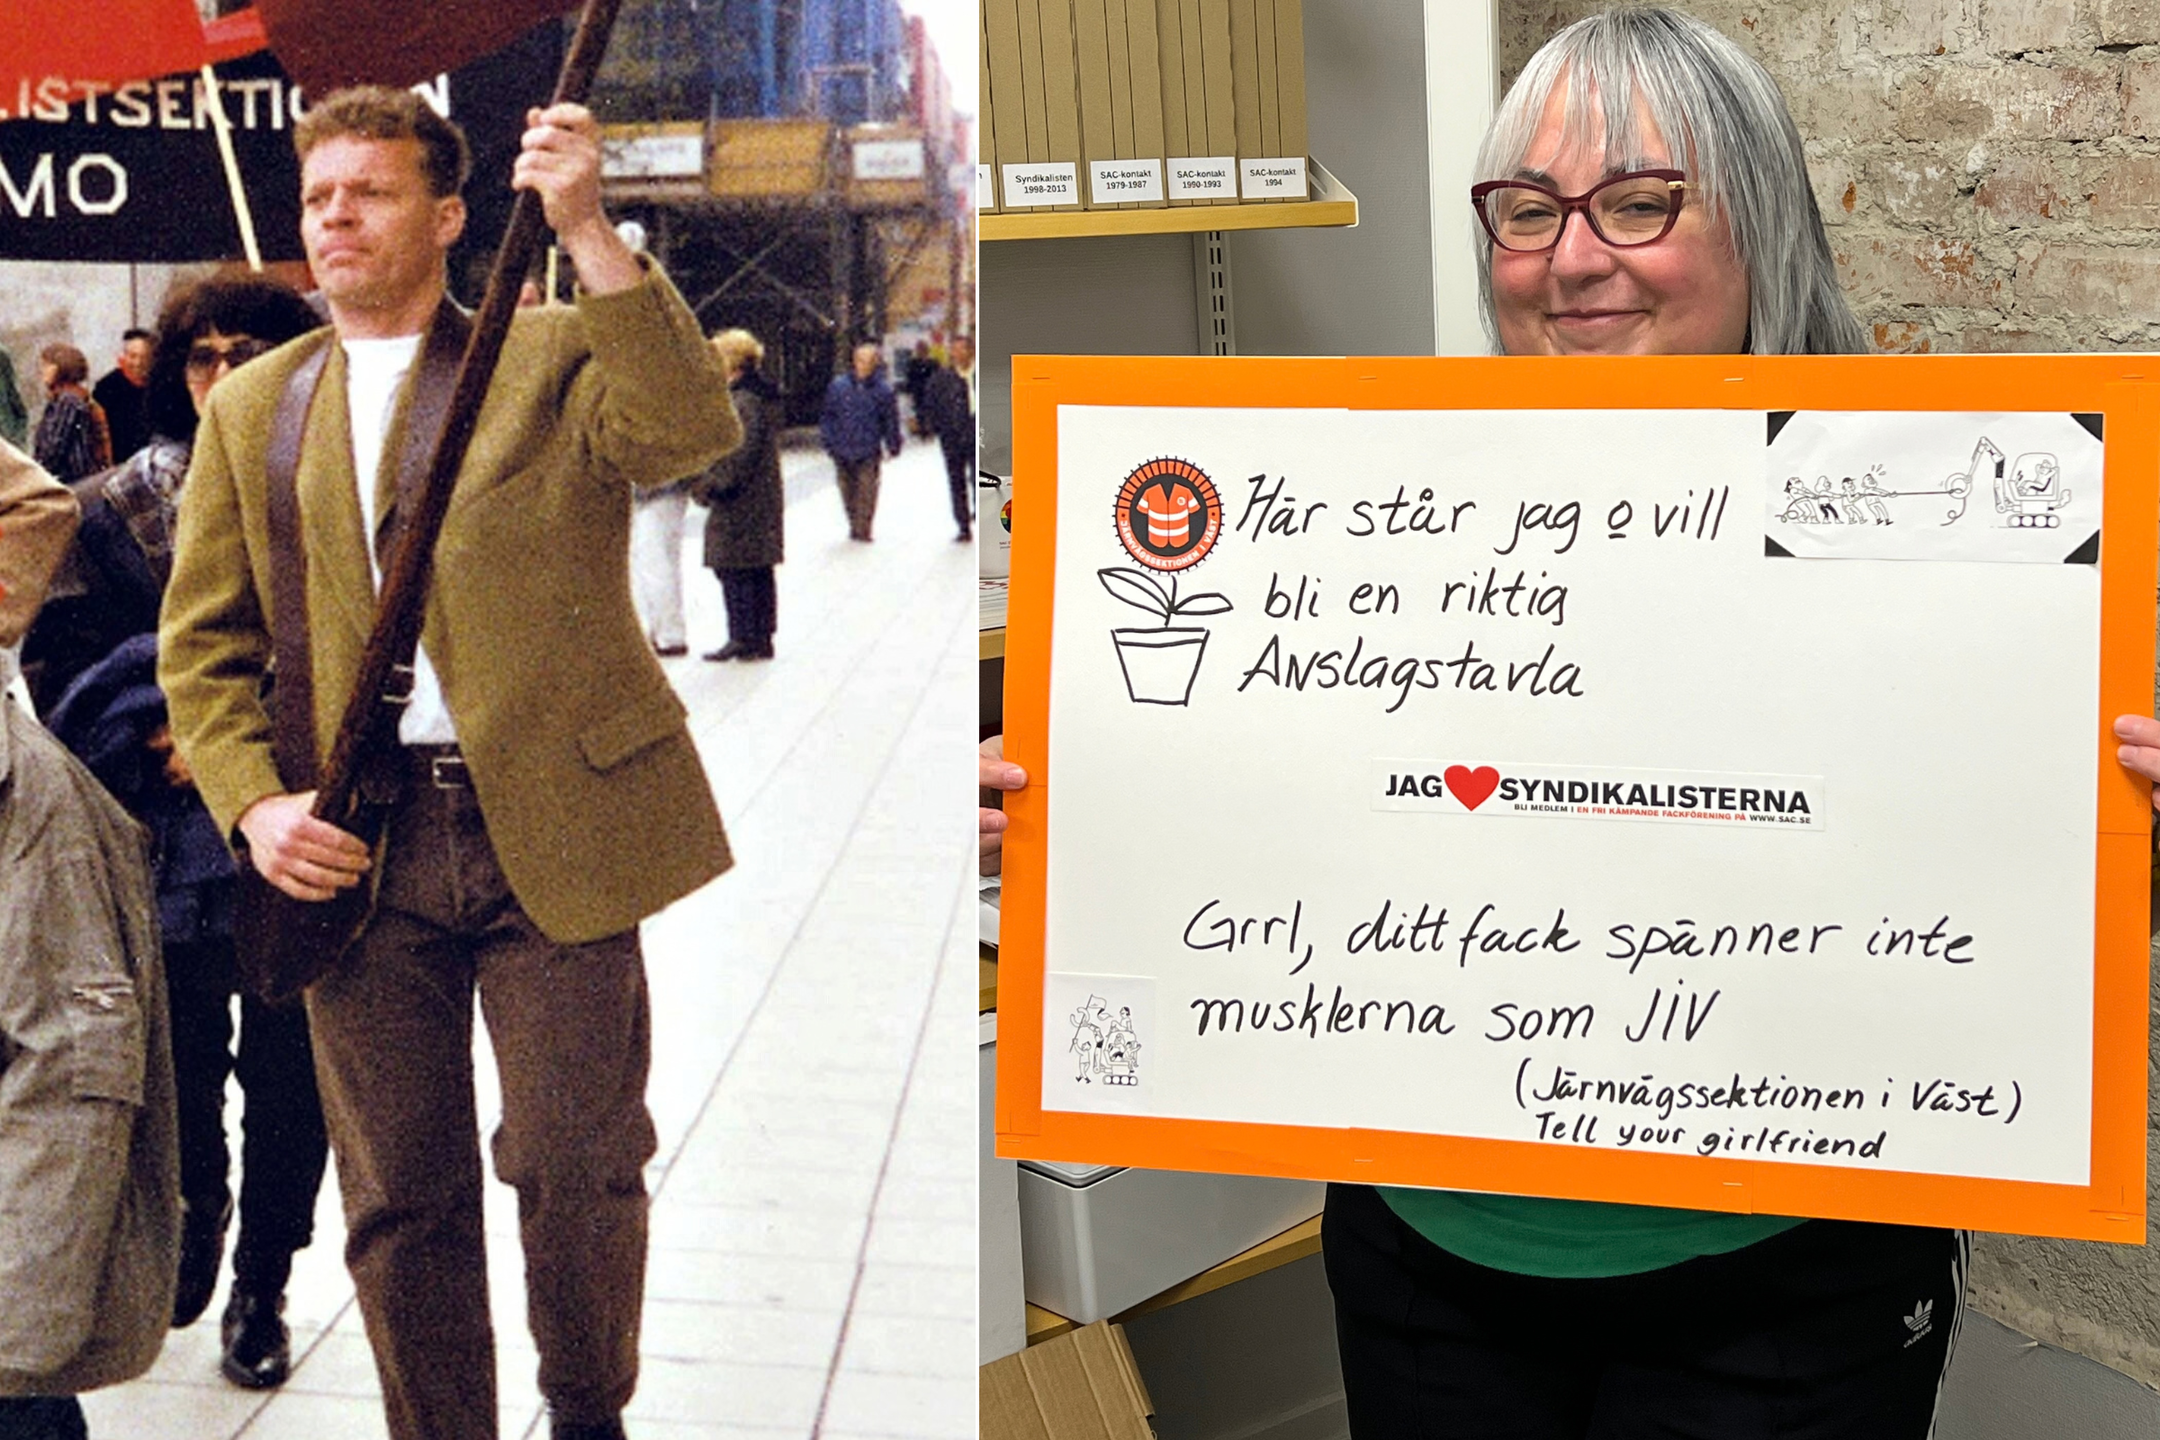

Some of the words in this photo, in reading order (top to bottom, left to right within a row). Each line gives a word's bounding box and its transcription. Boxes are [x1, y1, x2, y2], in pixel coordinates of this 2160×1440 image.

[1015, 174, 1073, 184] Syndikalisten
[1100, 170, 1152, 179] SAC-kontakt
[1176, 170, 1226, 179] SAC-kontakt
[1249, 168, 1297, 177] SAC-kontakt
[1265, 178, 1283, 187] 1994
[1024, 184, 1067, 194] 1998-2013
[1106, 180, 1147, 190] 1979-1987
[1182, 180, 1222, 189] 1990-1993
[1235, 473, 1329, 544] Här
[1345, 484, 1477, 537] står
[1492, 500, 1582, 556] jag
[1654, 484, 1730, 541] vill
[1203, 518, 1218, 544] VÄST
[1263, 571, 1322, 622] bli
[1348, 582, 1400, 615] en
[1440, 566, 1569, 627] riktig
[1385, 774, 1442, 798] JAG
[1499, 777, 1811, 814] SYNDIKALISTERNA
[1514, 803, 1528, 811] BLI
[1530, 804, 1568, 812] MEDLEM
[1592, 806, 1606, 814] FRI
[1609, 807, 1659, 817] KÄMPANDE
[1662, 810, 1732, 820] FACKFÖRENING
[1734, 812, 1746, 821] PÅ
[1749, 814, 1811, 824] WWW.SAC.SE
[1182, 898, 1314, 976] Grrl,
[1346, 898, 1450, 955] ditt
[1458, 903, 1582, 969] fack
[1605, 918, 1843, 975] spänner
[1866, 914, 1975, 965] inte
[1189, 981, 1456, 1039] musklerna
[1484, 1002, 1595, 1042] som
[1881, 1077, 1894, 1108] i
[1535, 1110, 1599, 1144] Tell
[1617, 1123, 1686, 1146] your
[1697, 1126, 1887, 1159] girlfriend
